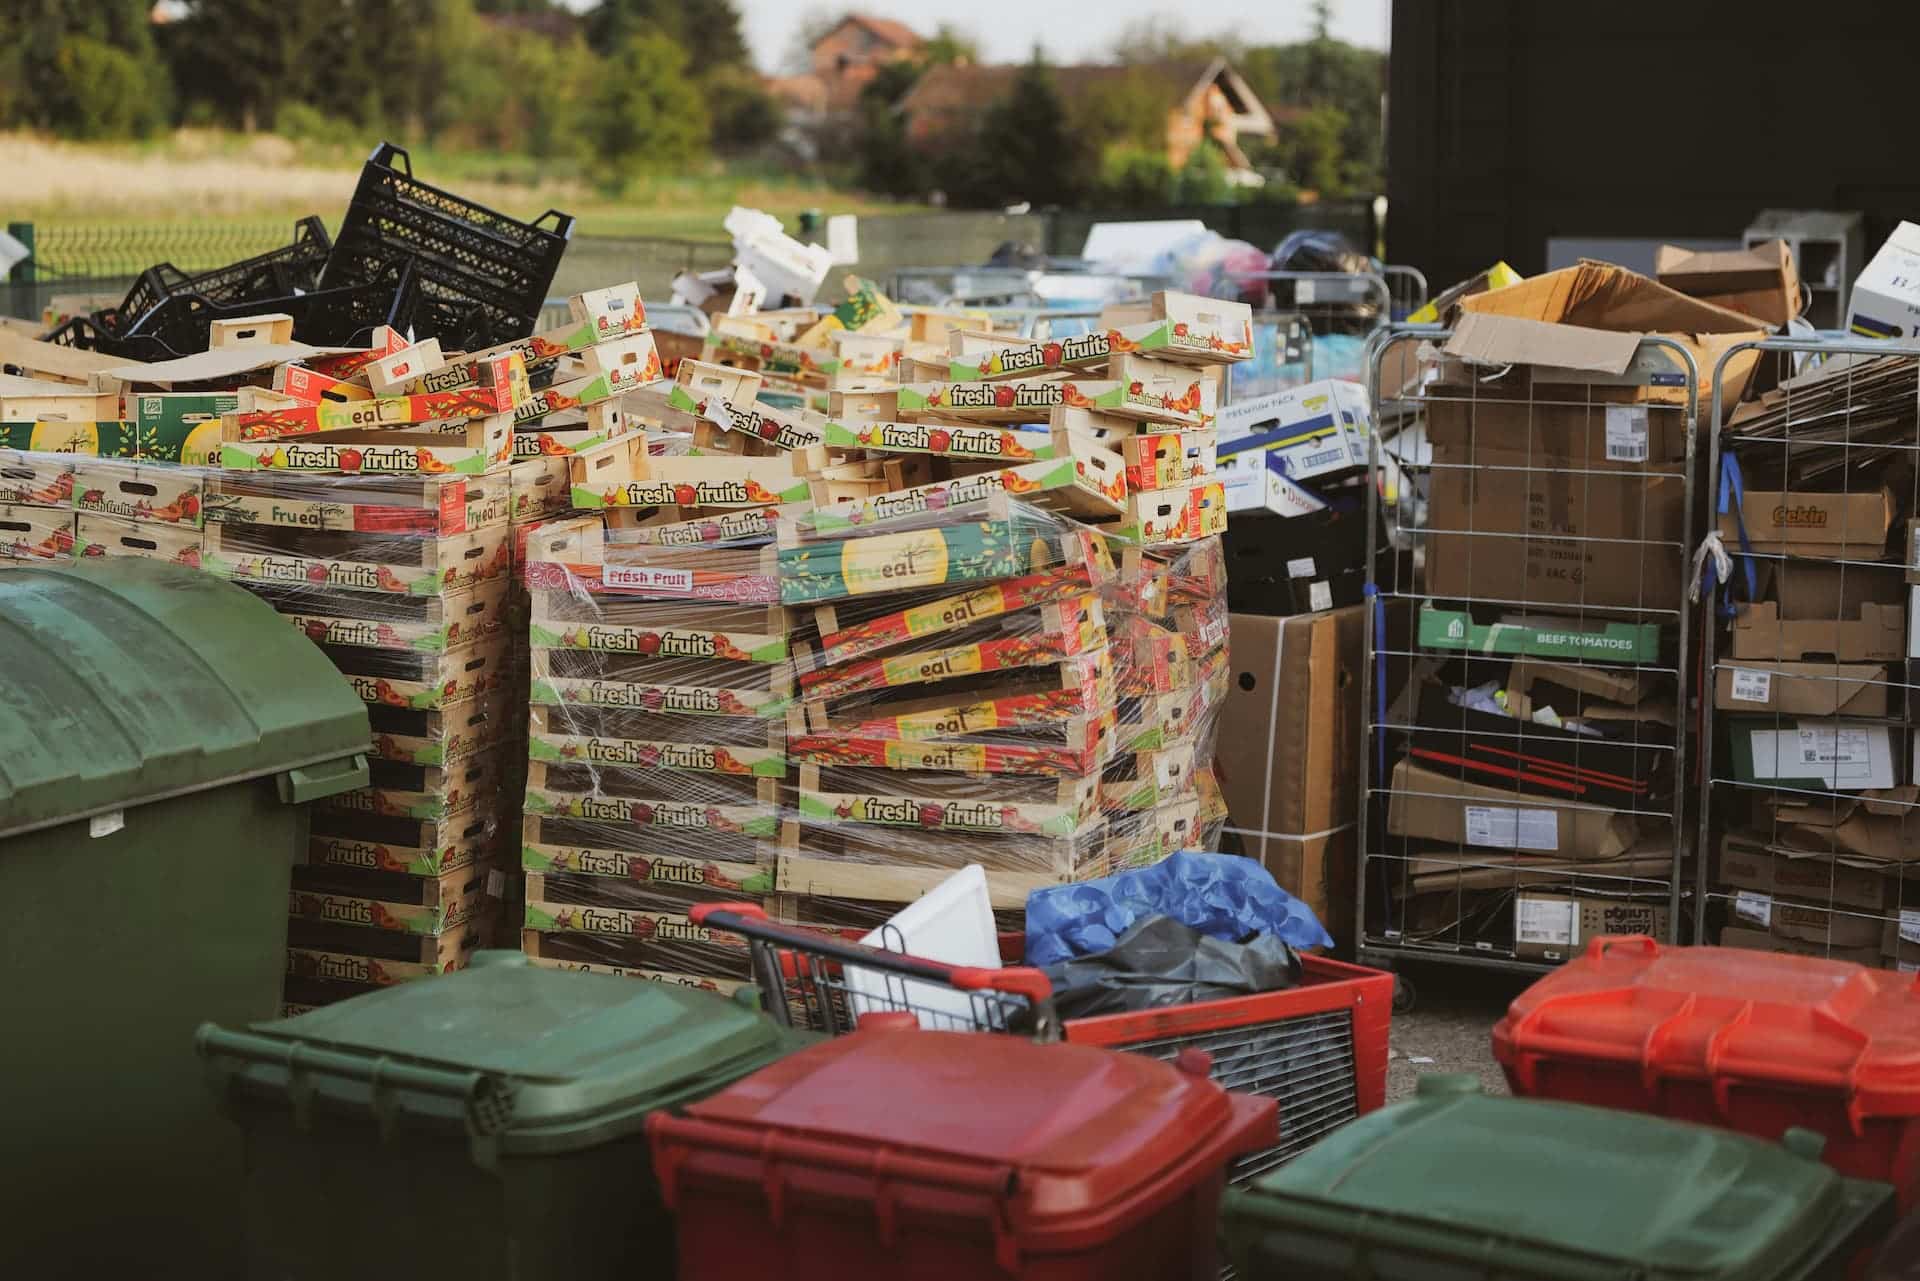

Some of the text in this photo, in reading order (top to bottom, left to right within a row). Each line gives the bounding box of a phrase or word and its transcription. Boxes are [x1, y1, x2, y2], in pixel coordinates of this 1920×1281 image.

[1001, 335, 1111, 371] fresh fruits
[424, 363, 471, 393] fresh
[951, 384, 1064, 406] fresh fruits
[883, 425, 1002, 455] fresh fruits
[288, 446, 419, 471] fresh fruits
[628, 481, 749, 505] fresh fruits
[874, 489, 928, 520] fresh
[659, 512, 769, 546] fresh fruits
[261, 557, 378, 588] fresh fruits
[327, 621, 378, 645] fruits
[588, 627, 715, 657] fresh fruits
[1536, 634, 1633, 650] BEEF TOMATOES
[591, 682, 720, 712] fresh fruits
[587, 739, 715, 769] fresh fruits
[582, 798, 707, 828] fresh fruits
[865, 797, 1003, 827] fresh fruits
[327, 840, 377, 867] fruits
[579, 851, 704, 883] fresh fruits
[320, 896, 371, 922] fruits
[583, 910, 710, 942] fresh fruits
[317, 955, 369, 980] fruits
